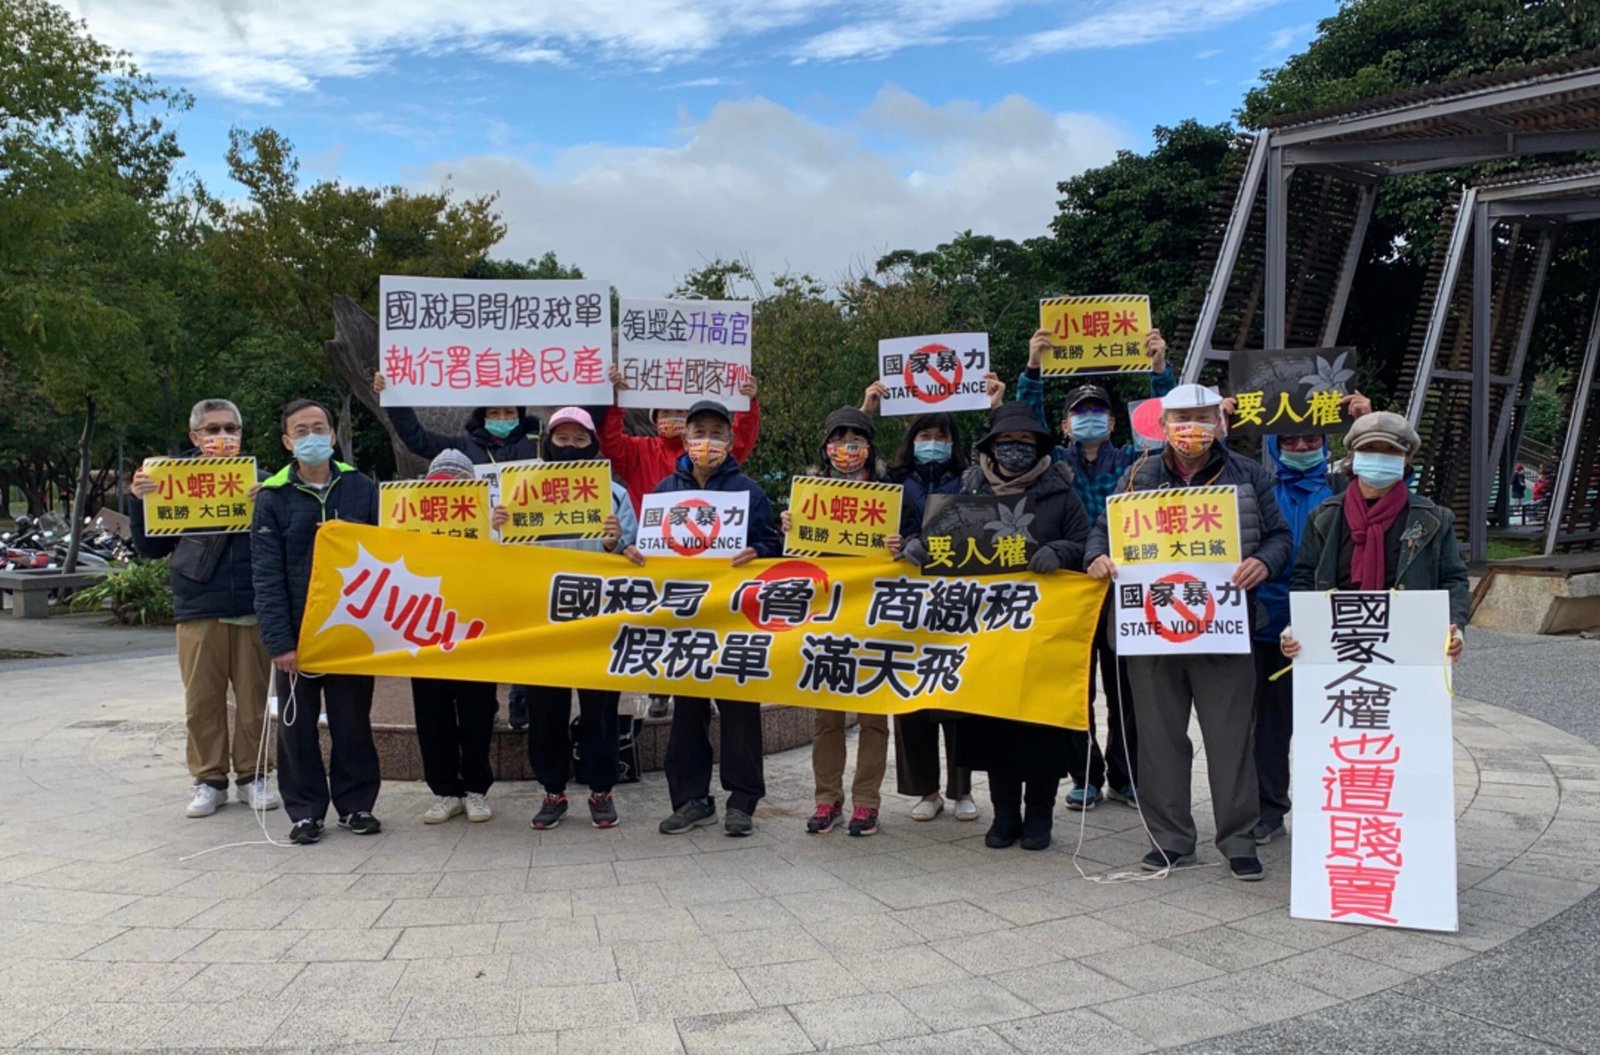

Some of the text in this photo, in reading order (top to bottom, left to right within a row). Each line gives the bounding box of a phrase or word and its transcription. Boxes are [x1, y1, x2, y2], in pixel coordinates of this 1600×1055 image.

[1054, 309, 1138, 339] 小蝦米
[883, 349, 985, 376] 國家暴力
[1052, 341, 1140, 360] 戰勝 大白鯊
[883, 380, 987, 400] STATE VIOLENCE
[1232, 390, 1343, 428] 要人權
[157, 472, 244, 500] 小蝦米
[512, 477, 599, 507] 小蝦米
[157, 503, 247, 521] 戰勝 大白鯊
[391, 495, 478, 524] 小蝦米
[512, 509, 602, 528] 戰勝 大白鯊
[643, 505, 745, 529] 國家暴力
[801, 493, 887, 527] 小蝦米
[1122, 503, 1223, 539] 小蝦米
[639, 536, 743, 550] STATE VIOLENCE
[798, 525, 886, 549] 戰勝 大白鯊
[1122, 539, 1227, 562] 戰勝 大白鯊
[925, 534, 1029, 569] 要人權
[1120, 580, 1242, 609] 國家暴力
[1120, 620, 1244, 637] STATE VIOLENCE
[610, 624, 969, 698] 假稅單 滿天飛
[1320, 592, 1404, 924] 國家人權也遭賤賣
